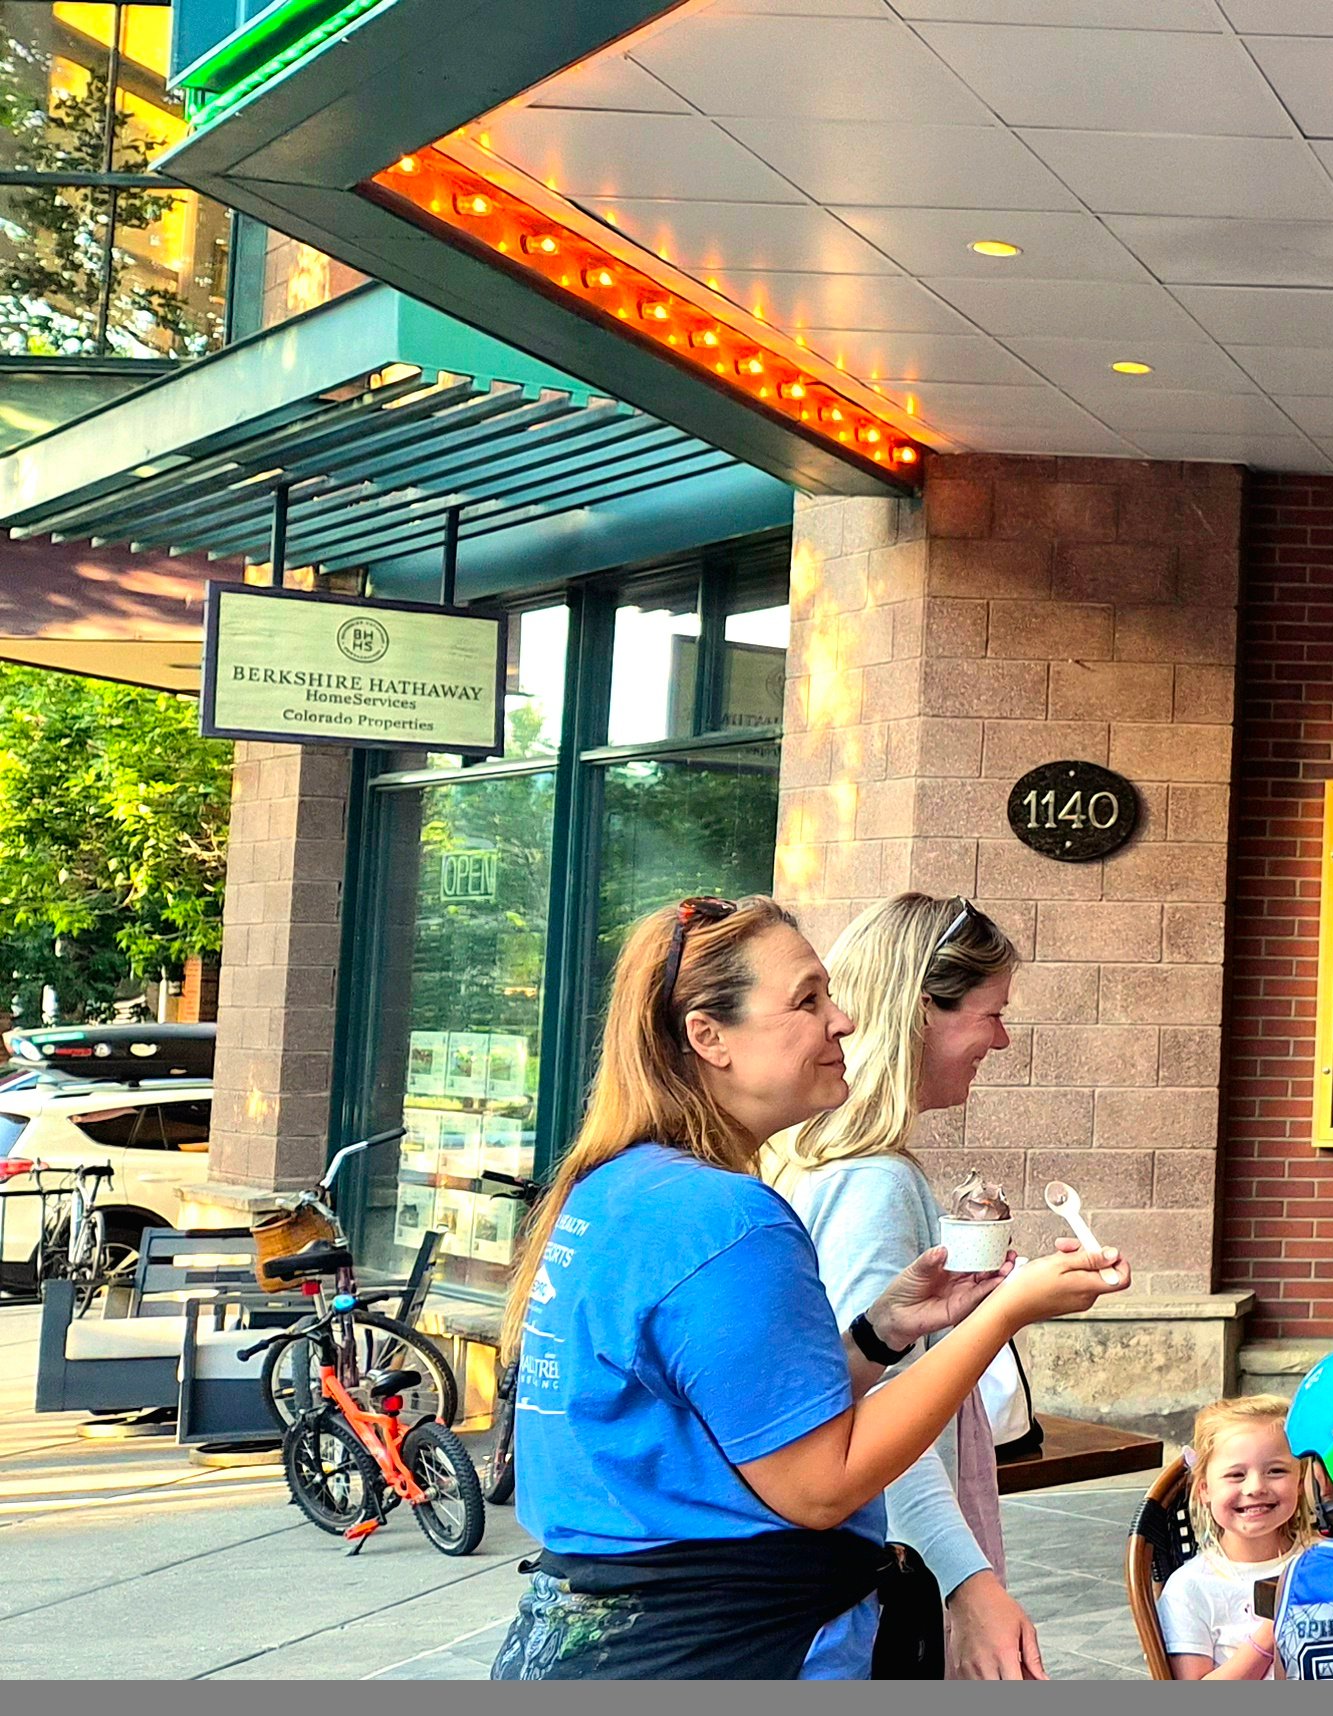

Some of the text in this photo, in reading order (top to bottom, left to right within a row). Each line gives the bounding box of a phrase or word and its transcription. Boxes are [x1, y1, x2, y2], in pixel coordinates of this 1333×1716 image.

[233, 665, 483, 701] BERKSHIRE HATHAWAY
[306, 688, 417, 710] HomeServices
[283, 709, 434, 732] Colorado Properties
[1023, 790, 1119, 829] 1140
[444, 855, 494, 896] OPEN
